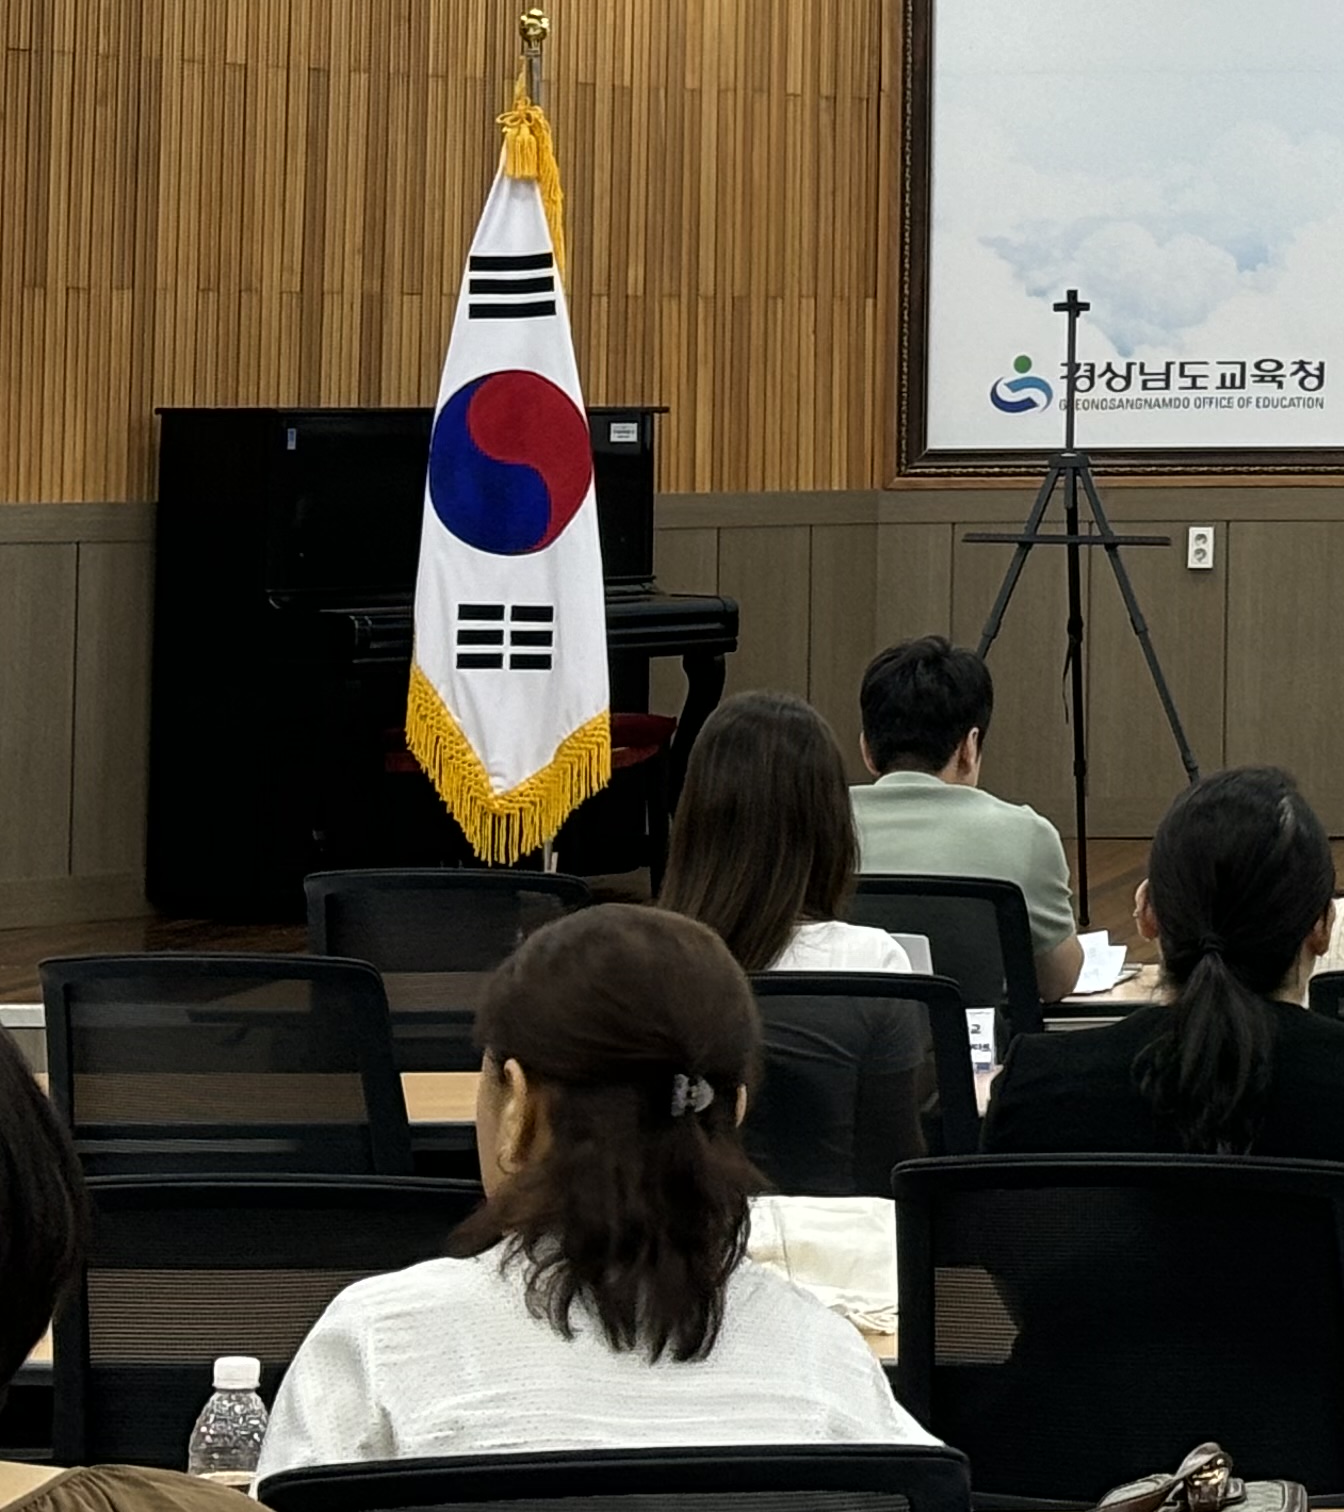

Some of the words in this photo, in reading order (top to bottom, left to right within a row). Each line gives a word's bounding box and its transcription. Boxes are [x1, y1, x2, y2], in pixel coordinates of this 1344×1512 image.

[1059, 358, 1326, 393] 경상남도교육청
[1059, 396, 1190, 411] GEONGSANGNAMDO
[1194, 396, 1234, 409] OFFICE
[1237, 396, 1252, 409] OF
[1255, 396, 1325, 410] EDUCATION
